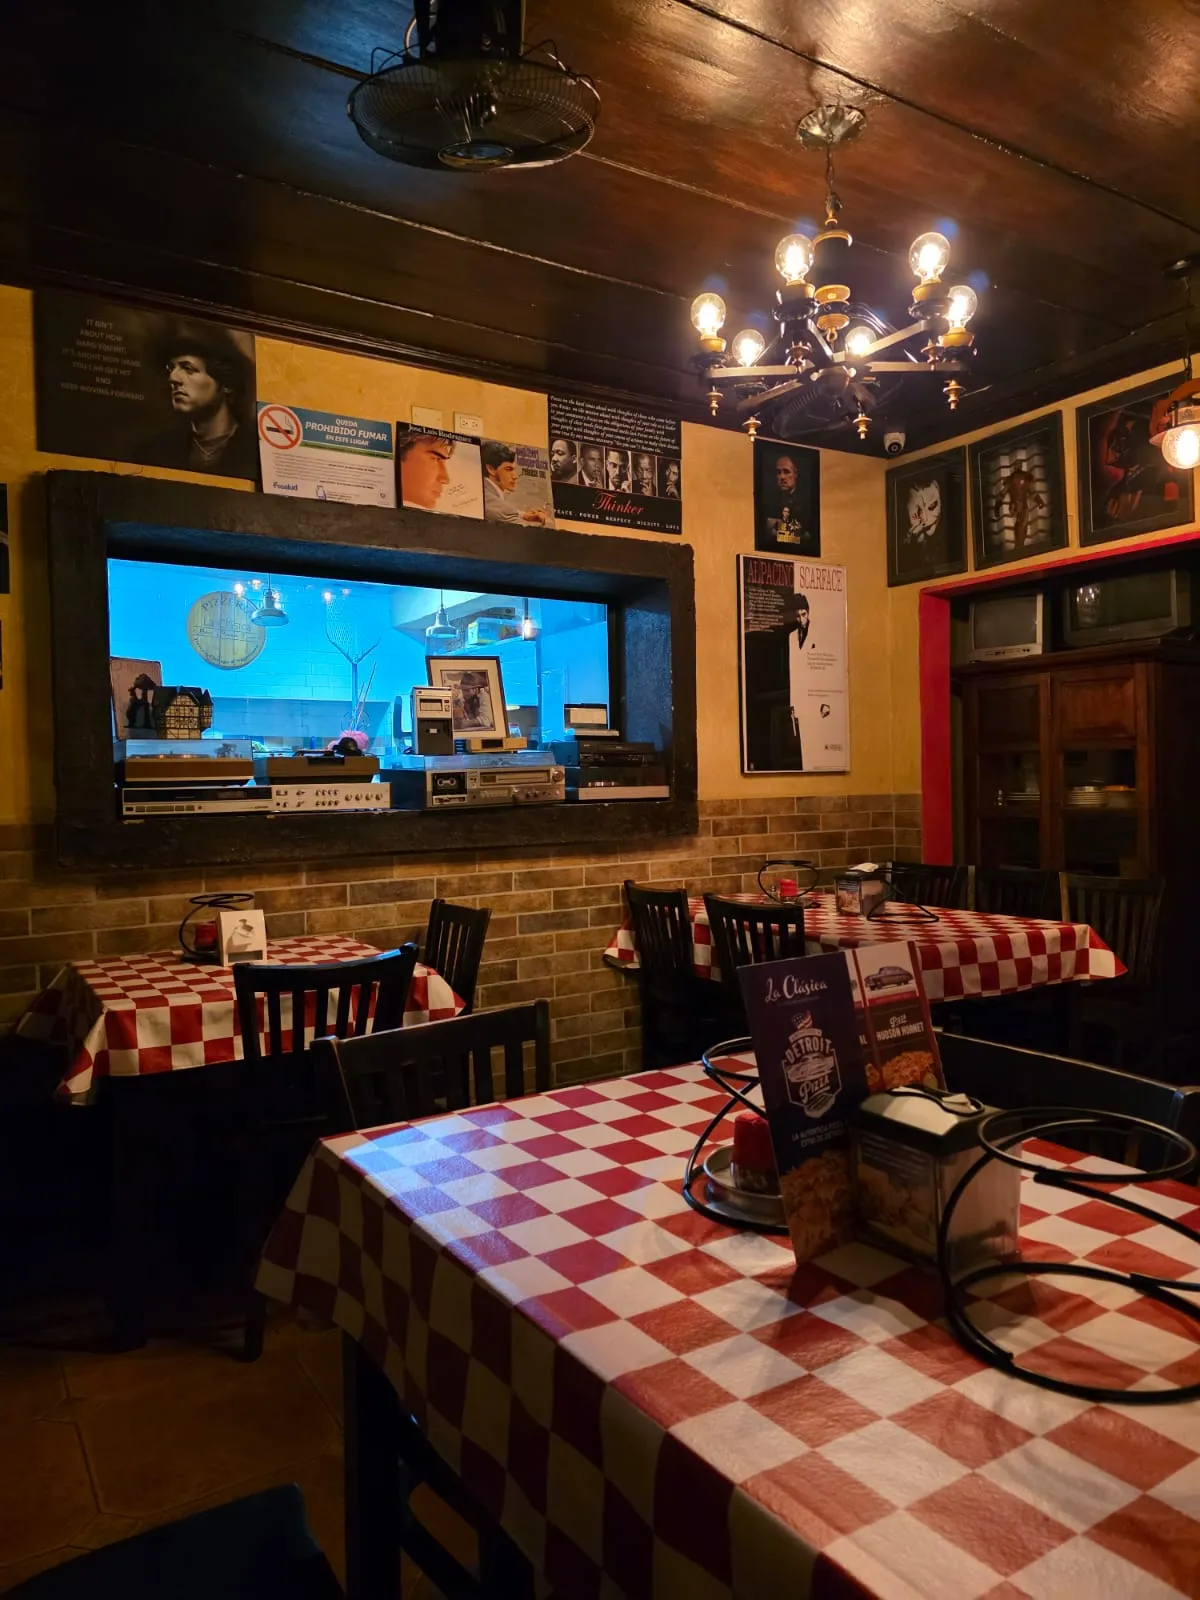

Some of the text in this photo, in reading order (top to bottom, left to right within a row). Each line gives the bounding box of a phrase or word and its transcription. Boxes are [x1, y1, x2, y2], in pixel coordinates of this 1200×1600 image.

[305, 421, 388, 441] PROHIBIDO FUMAR
[335, 418, 358, 428] QUEDA
[350, 437, 369, 446] LUGAR
[592, 492, 645, 515] Thinker
[606, 516, 631, 524] RESPECT
[748, 560, 842, 592] AL PACINO SCARFACE
[764, 977, 782, 1003] La
[782, 974, 828, 1000] Clásica
[876, 1026, 901, 1041] HUDSON
[784, 1036, 832, 1064] DETROIT
